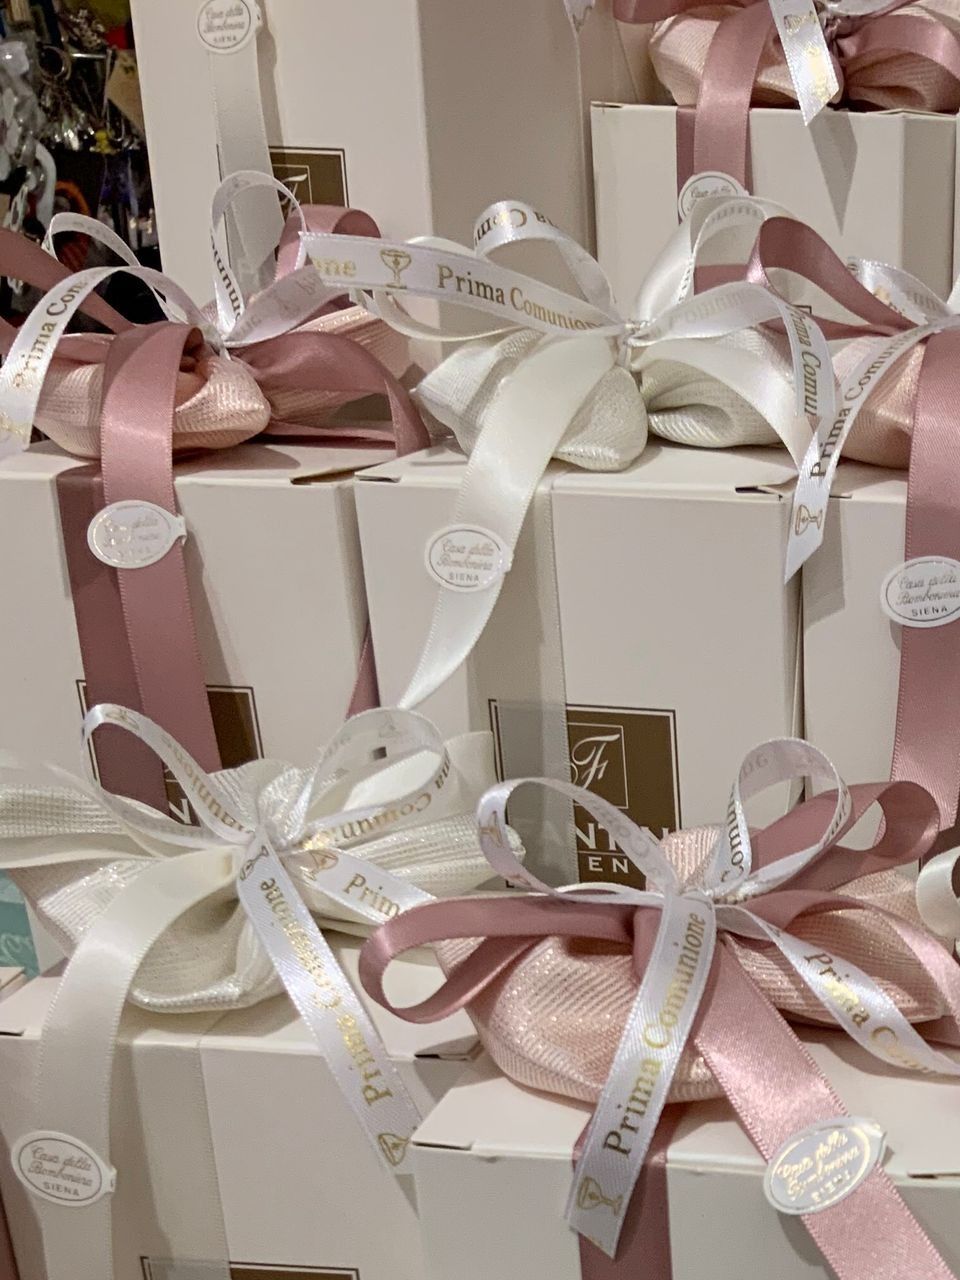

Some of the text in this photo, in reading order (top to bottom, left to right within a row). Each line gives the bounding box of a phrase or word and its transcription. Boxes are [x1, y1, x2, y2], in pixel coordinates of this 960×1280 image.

[436, 263, 505, 306] Prima
[808, 406, 851, 480] Prima
[911, 606, 949, 617] SIENA
[602, 910, 707, 1160] Prima Comunione
[335, 1012, 393, 1107] Prima
[31, 1143, 60, 1164] Casa
[42, 1181, 80, 1197] SIENA
